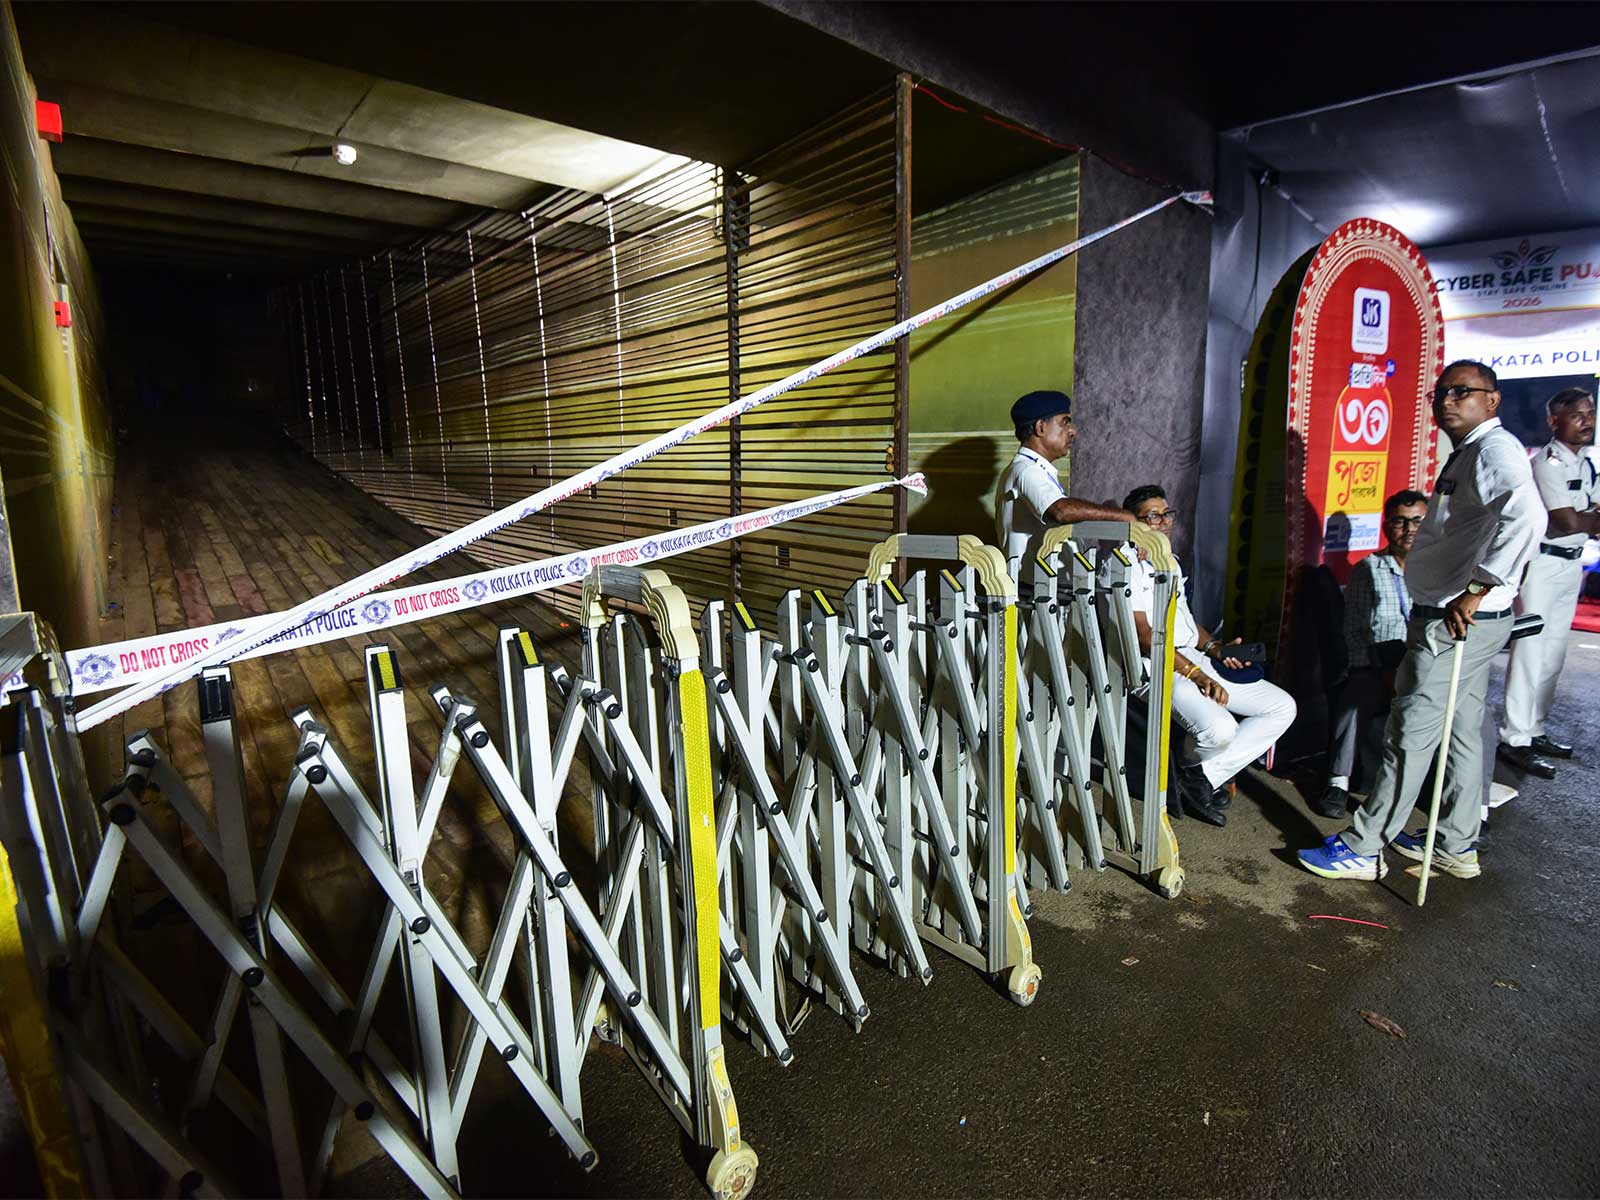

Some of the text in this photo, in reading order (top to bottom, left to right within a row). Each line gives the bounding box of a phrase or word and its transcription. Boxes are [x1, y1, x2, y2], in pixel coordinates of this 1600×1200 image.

[1435, 272, 1494, 293] CYBER
[1500, 267, 1554, 287] SAFE
[1477, 282, 1568, 297] STAY SAFE ONLINE
[1502, 297, 1542, 308] 2026
[660, 529, 716, 553] KOLKATA POLICE
[591, 547, 639, 567] DO NOT CROSS
[489, 563, 565, 594] KOLKATA POLICE
[394, 587, 460, 616] DO NOT CROSS
[316, 607, 358, 634] POLICE
[119, 638, 209, 674] DO NOT CROSS
